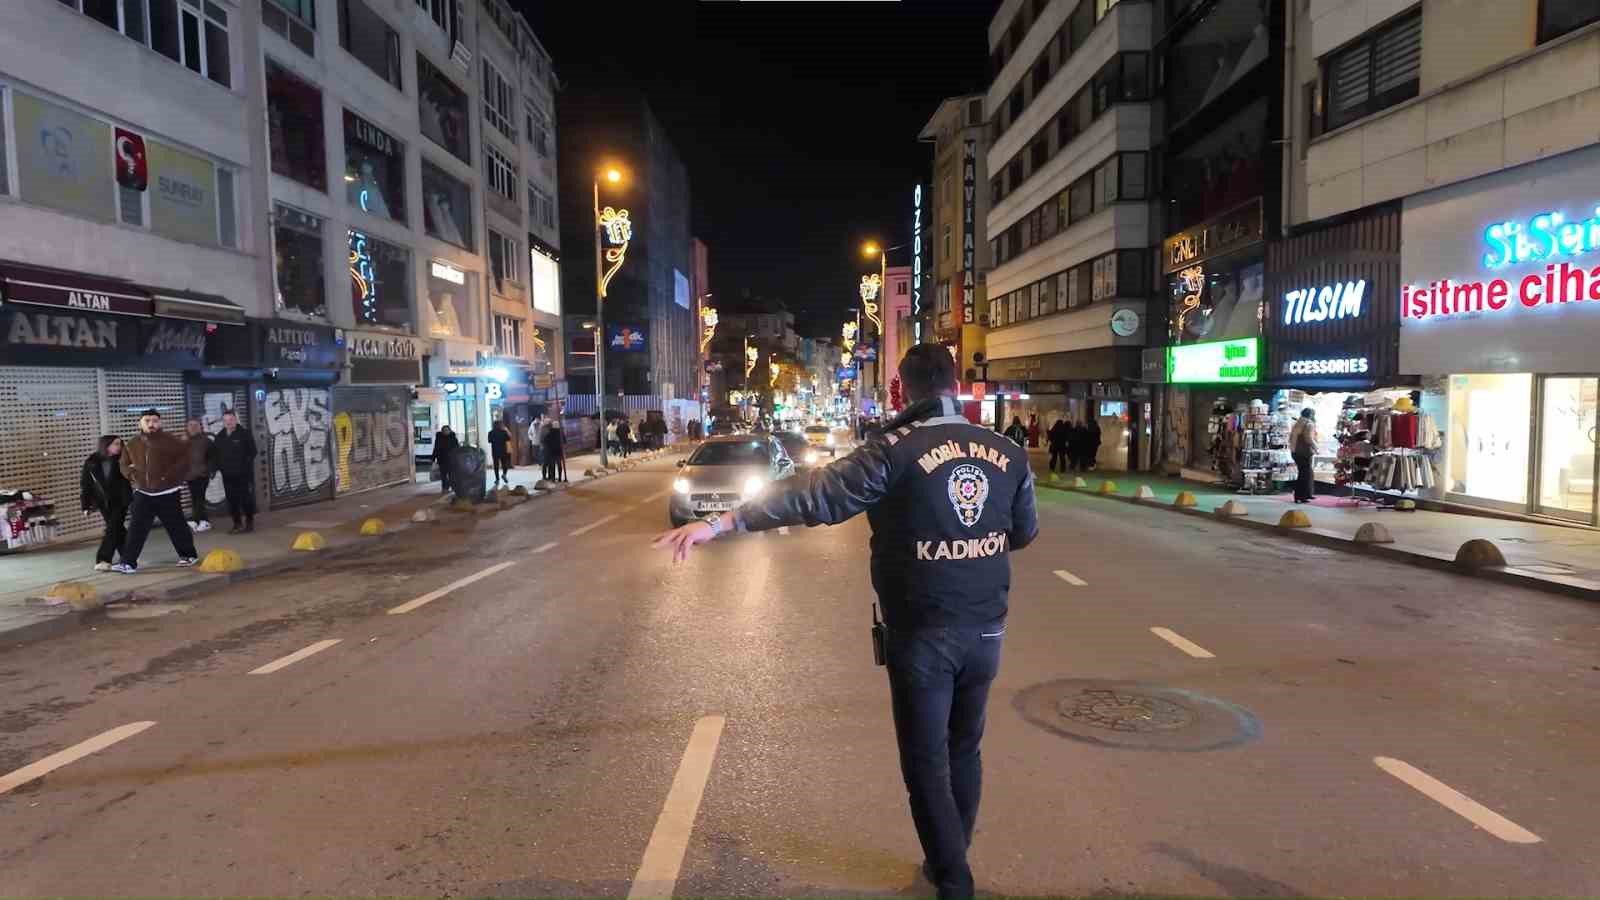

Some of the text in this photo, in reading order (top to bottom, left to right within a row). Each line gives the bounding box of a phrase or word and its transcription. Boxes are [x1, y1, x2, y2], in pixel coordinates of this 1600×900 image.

[912, 184, 922, 314] WEDDING
[963, 233, 975, 322] AJANS
[68, 291, 110, 311] ALTAN
[1283, 279, 1366, 327] TILSIM
[1402, 277, 1509, 320] işitme
[7, 311, 118, 349] ALTAN
[917, 439, 1011, 475] MOBİL PARK
[916, 531, 1008, 561] KADIKÖY
